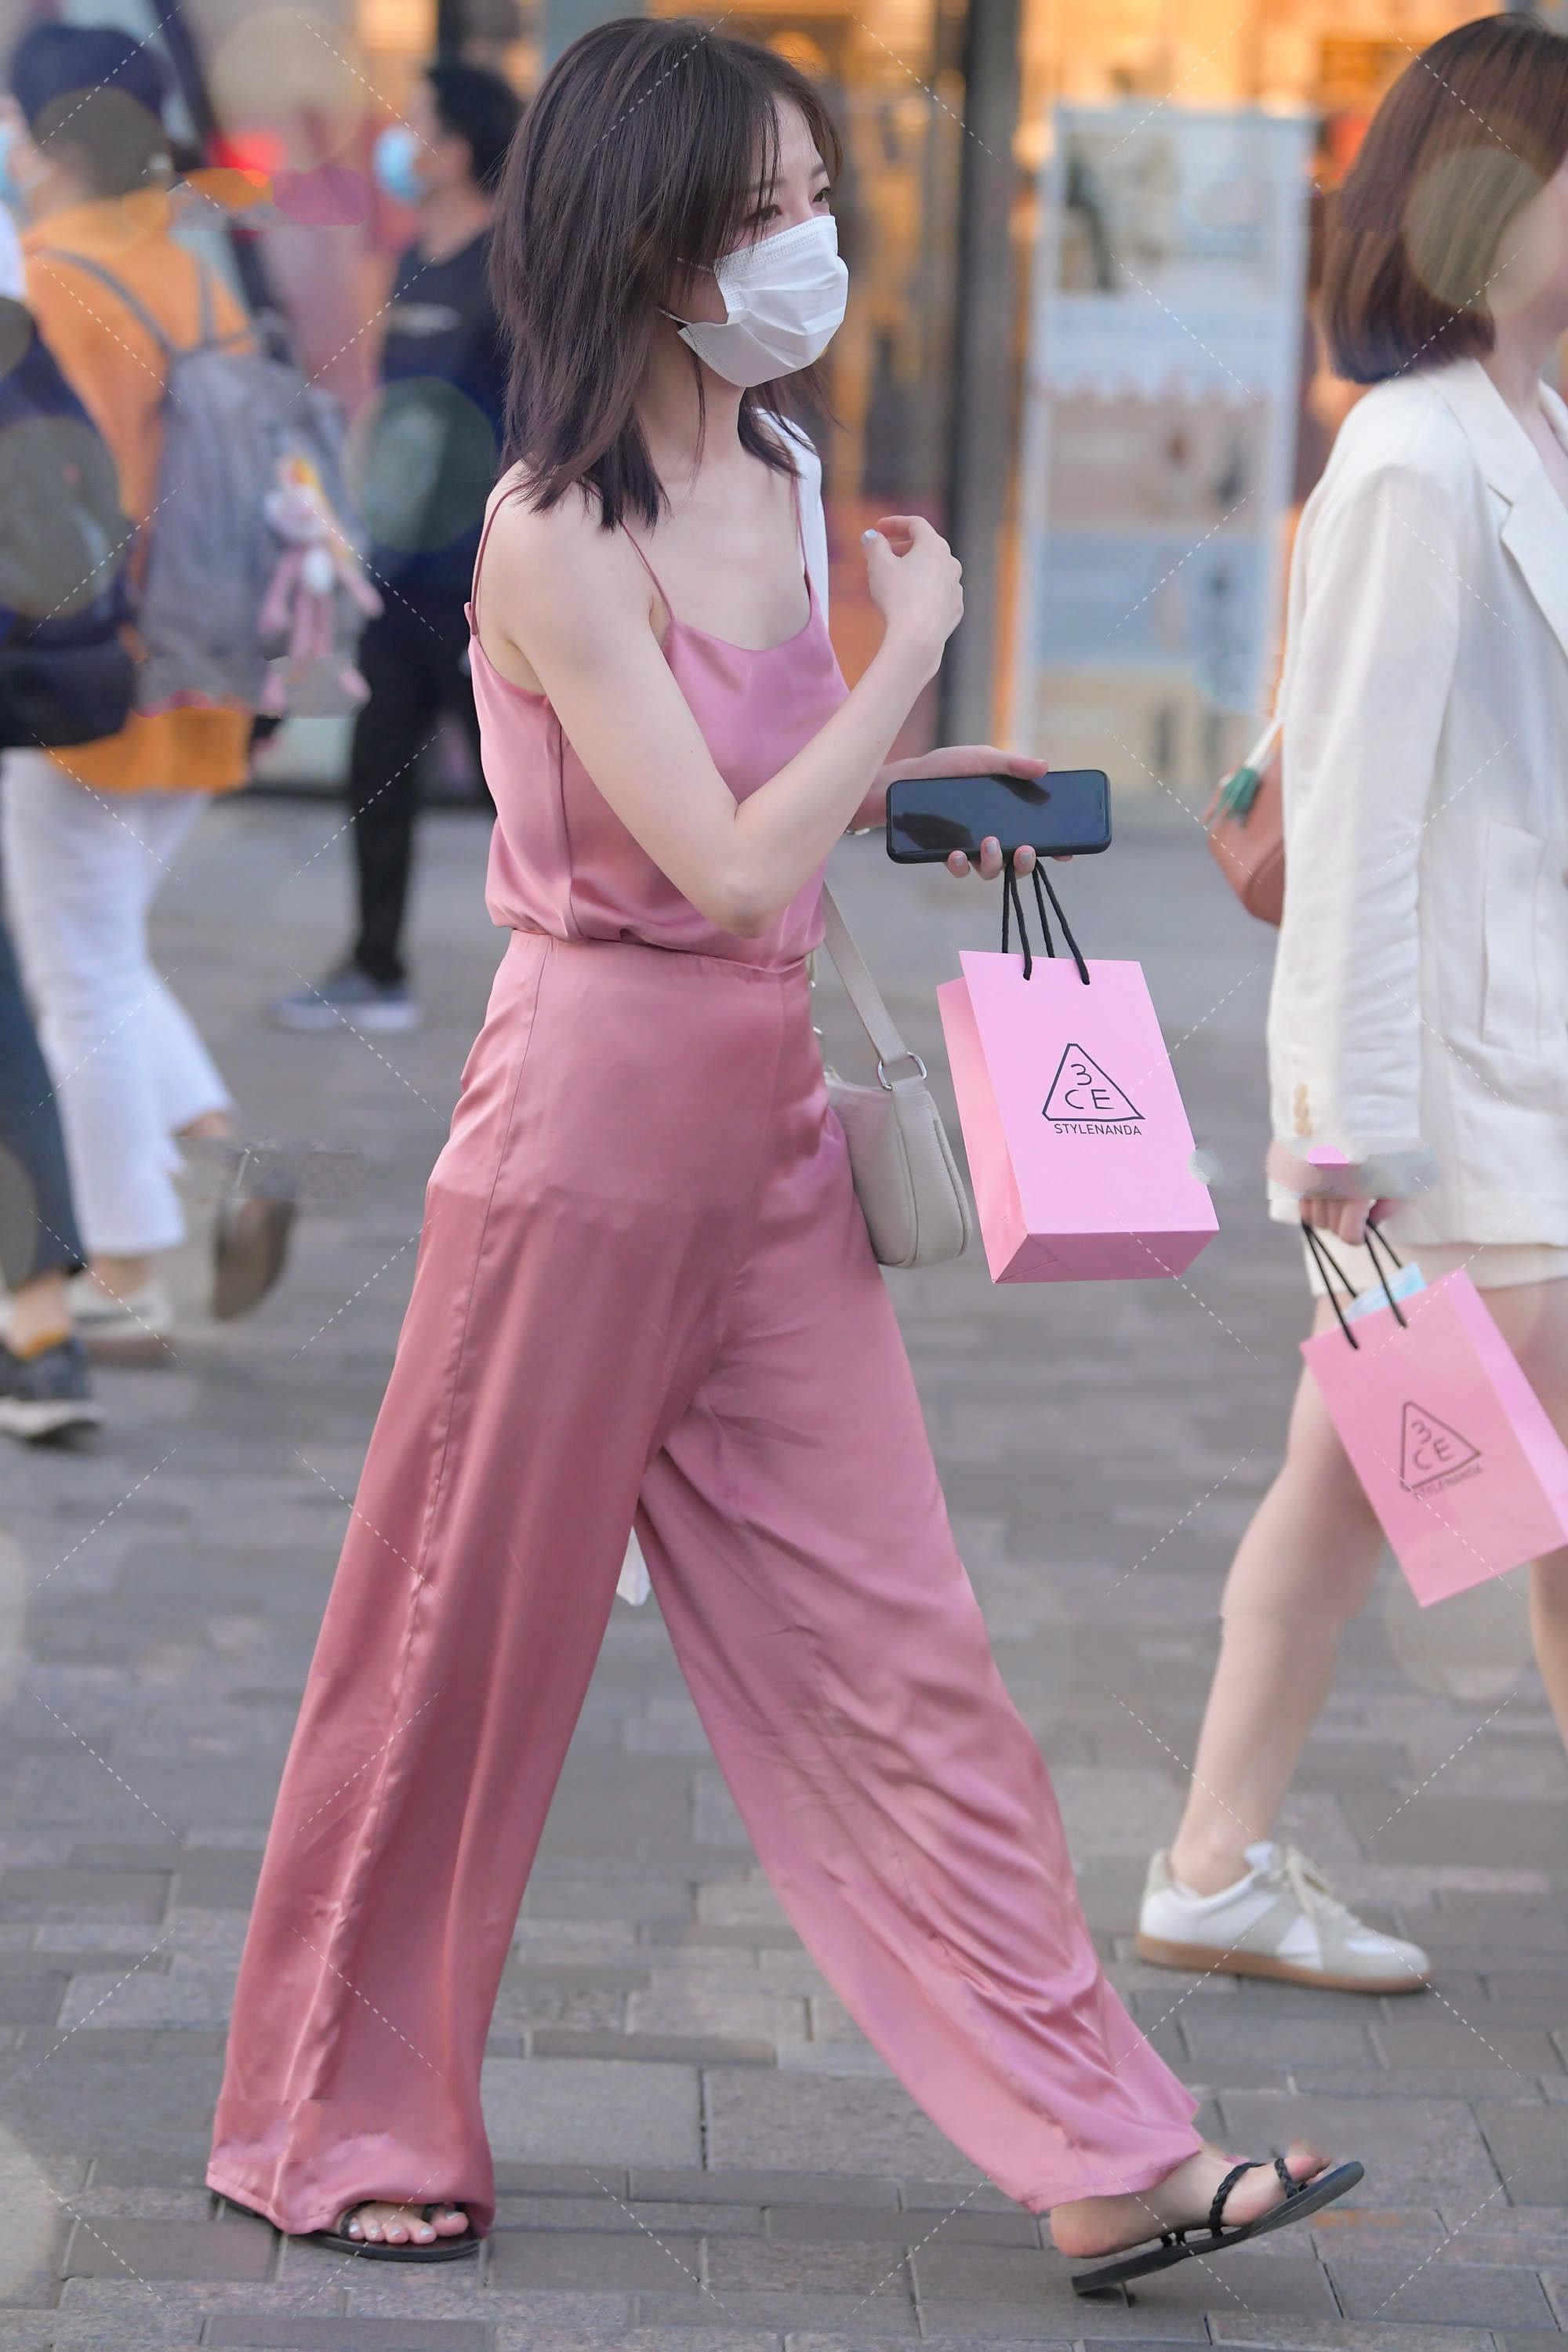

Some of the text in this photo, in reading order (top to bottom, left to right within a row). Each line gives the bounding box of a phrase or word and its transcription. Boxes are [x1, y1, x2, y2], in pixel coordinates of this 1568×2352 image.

[1070, 1063, 1092, 1085] 3
[1064, 1089, 1115, 1109] CE
[1054, 1123, 1142, 1135] STYLENANDA
[1410, 1420, 1432, 1444] 3
[1414, 1438, 1455, 1470] CE
